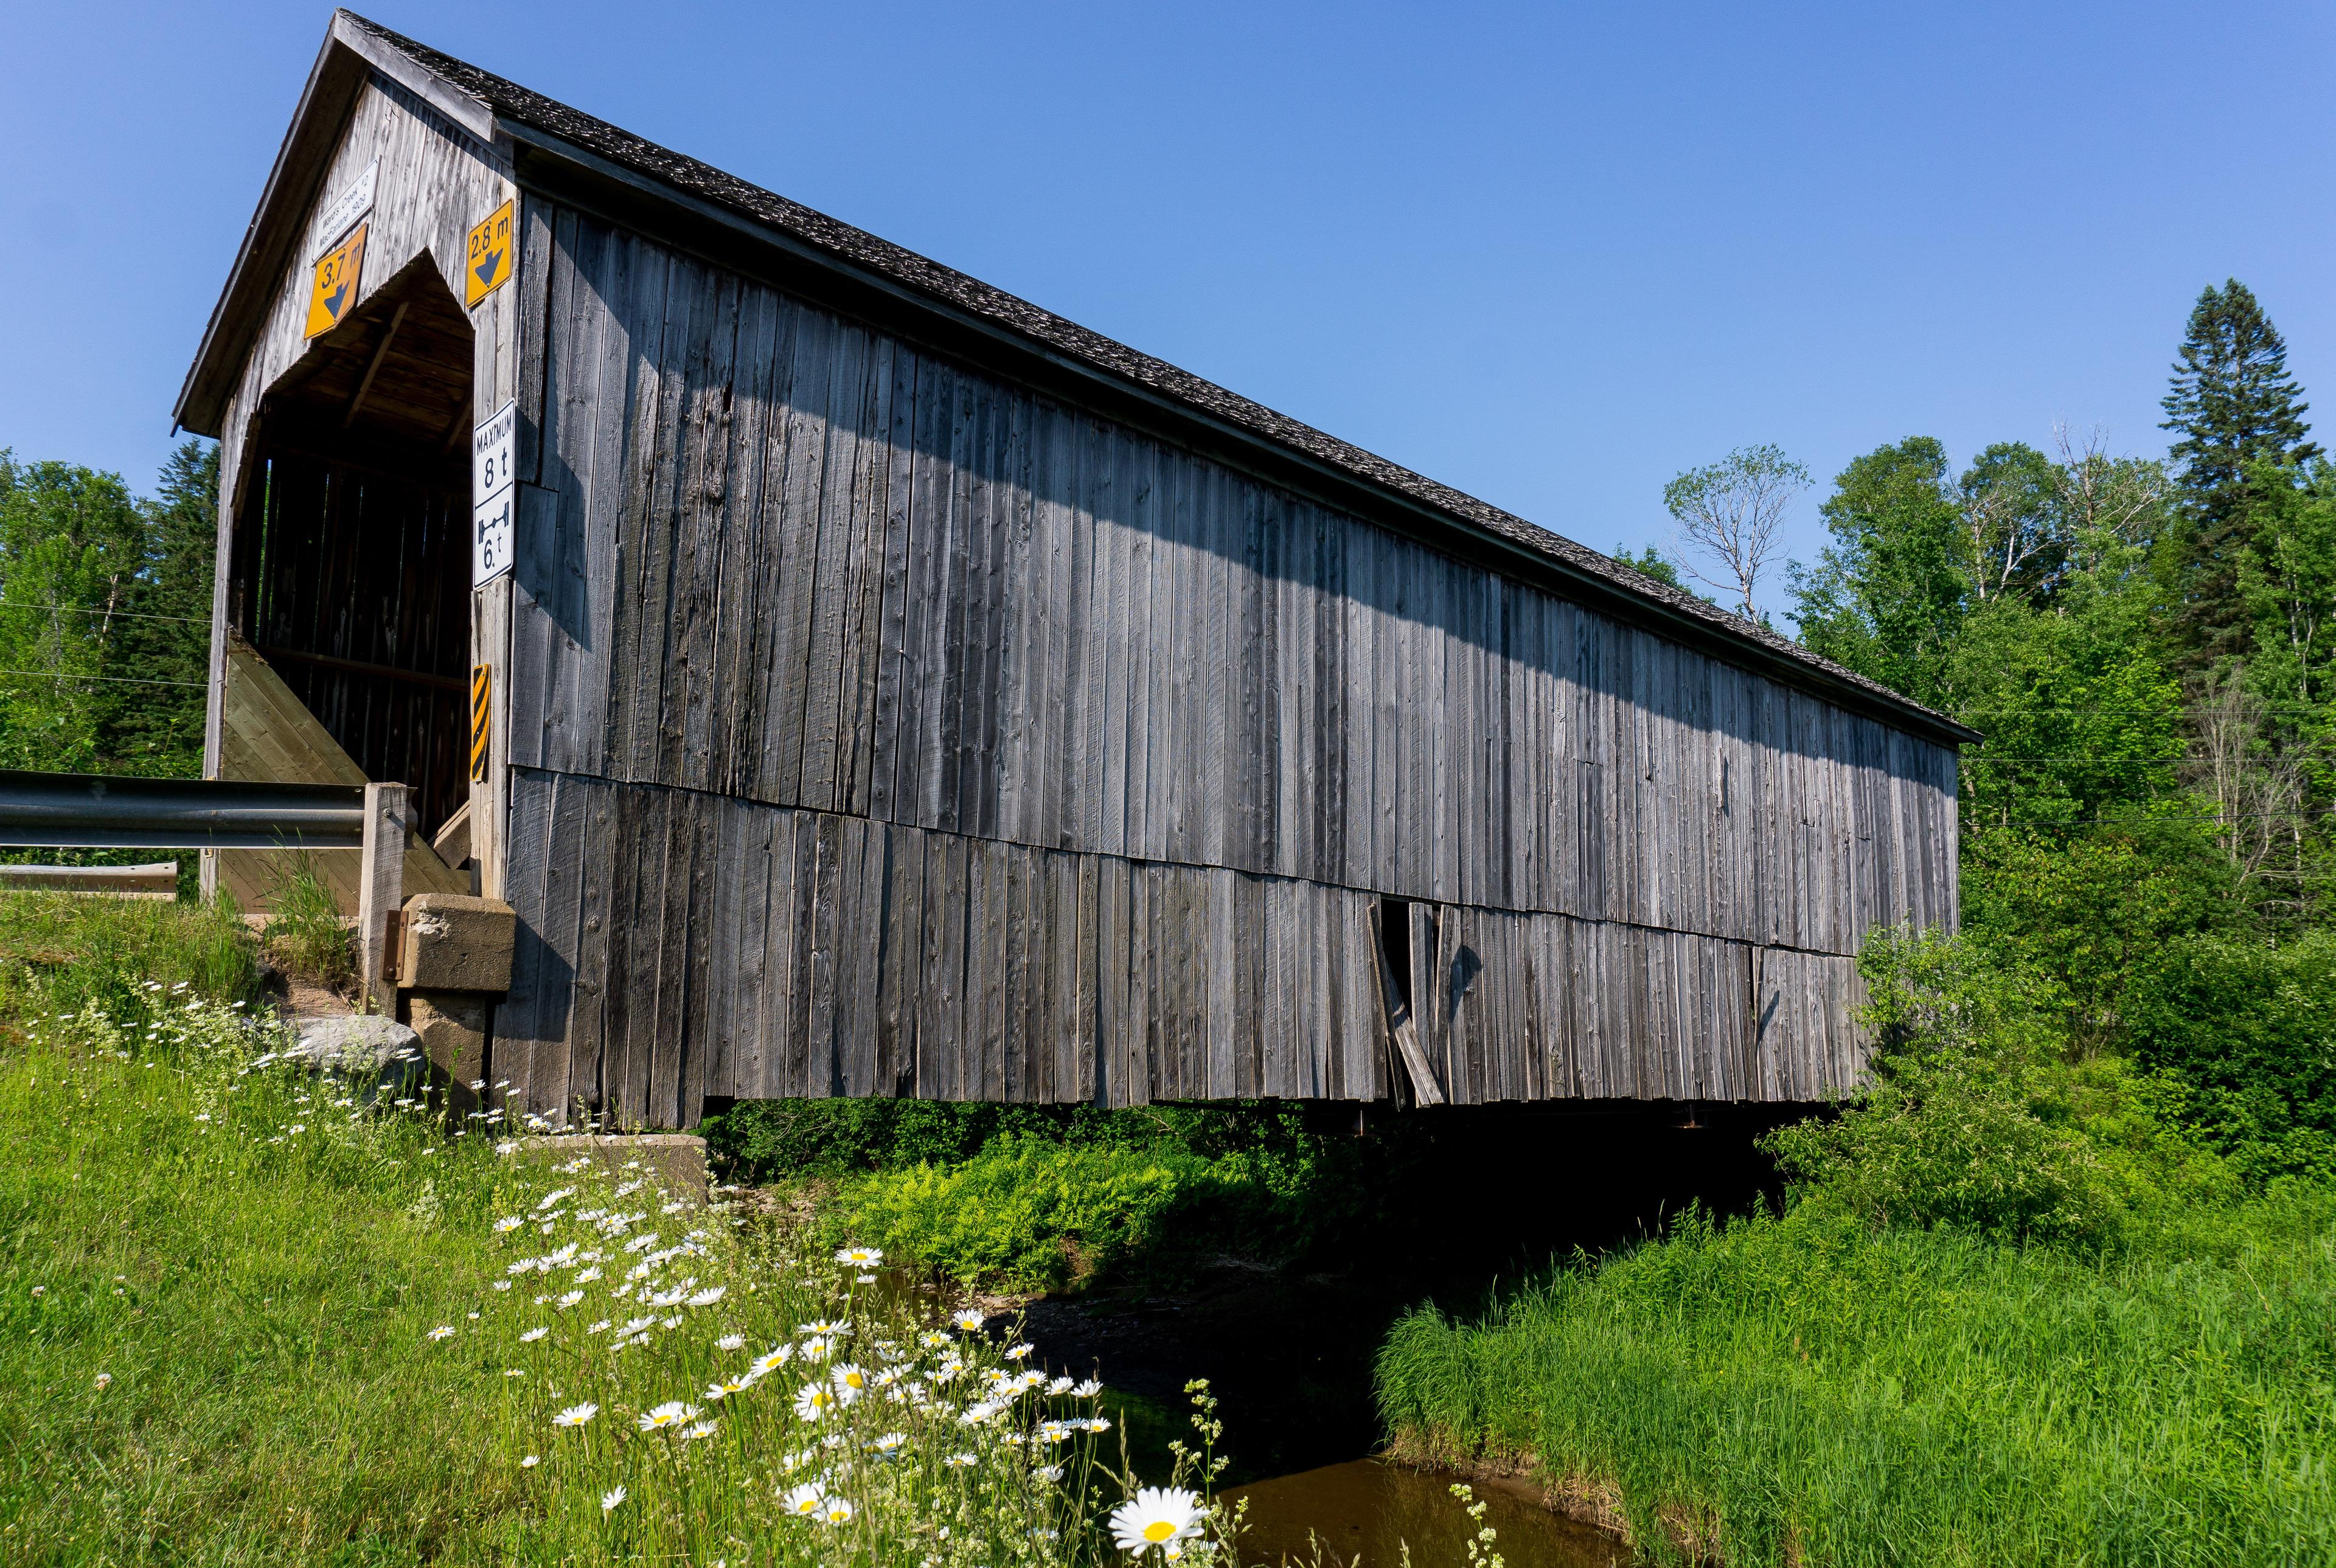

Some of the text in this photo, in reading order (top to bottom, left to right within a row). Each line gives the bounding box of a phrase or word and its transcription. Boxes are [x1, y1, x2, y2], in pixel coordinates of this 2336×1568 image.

[322, 207, 339, 230] Ward's
[342, 186, 358, 208] Creek
[352, 193, 366, 215] 1909
[471, 216, 508, 260] 2.8 m
[321, 242, 360, 289] 3.7 m
[477, 412, 512, 456] MAXIMUM
[485, 446, 507, 488] 8 t
[484, 532, 501, 569] 6 t
